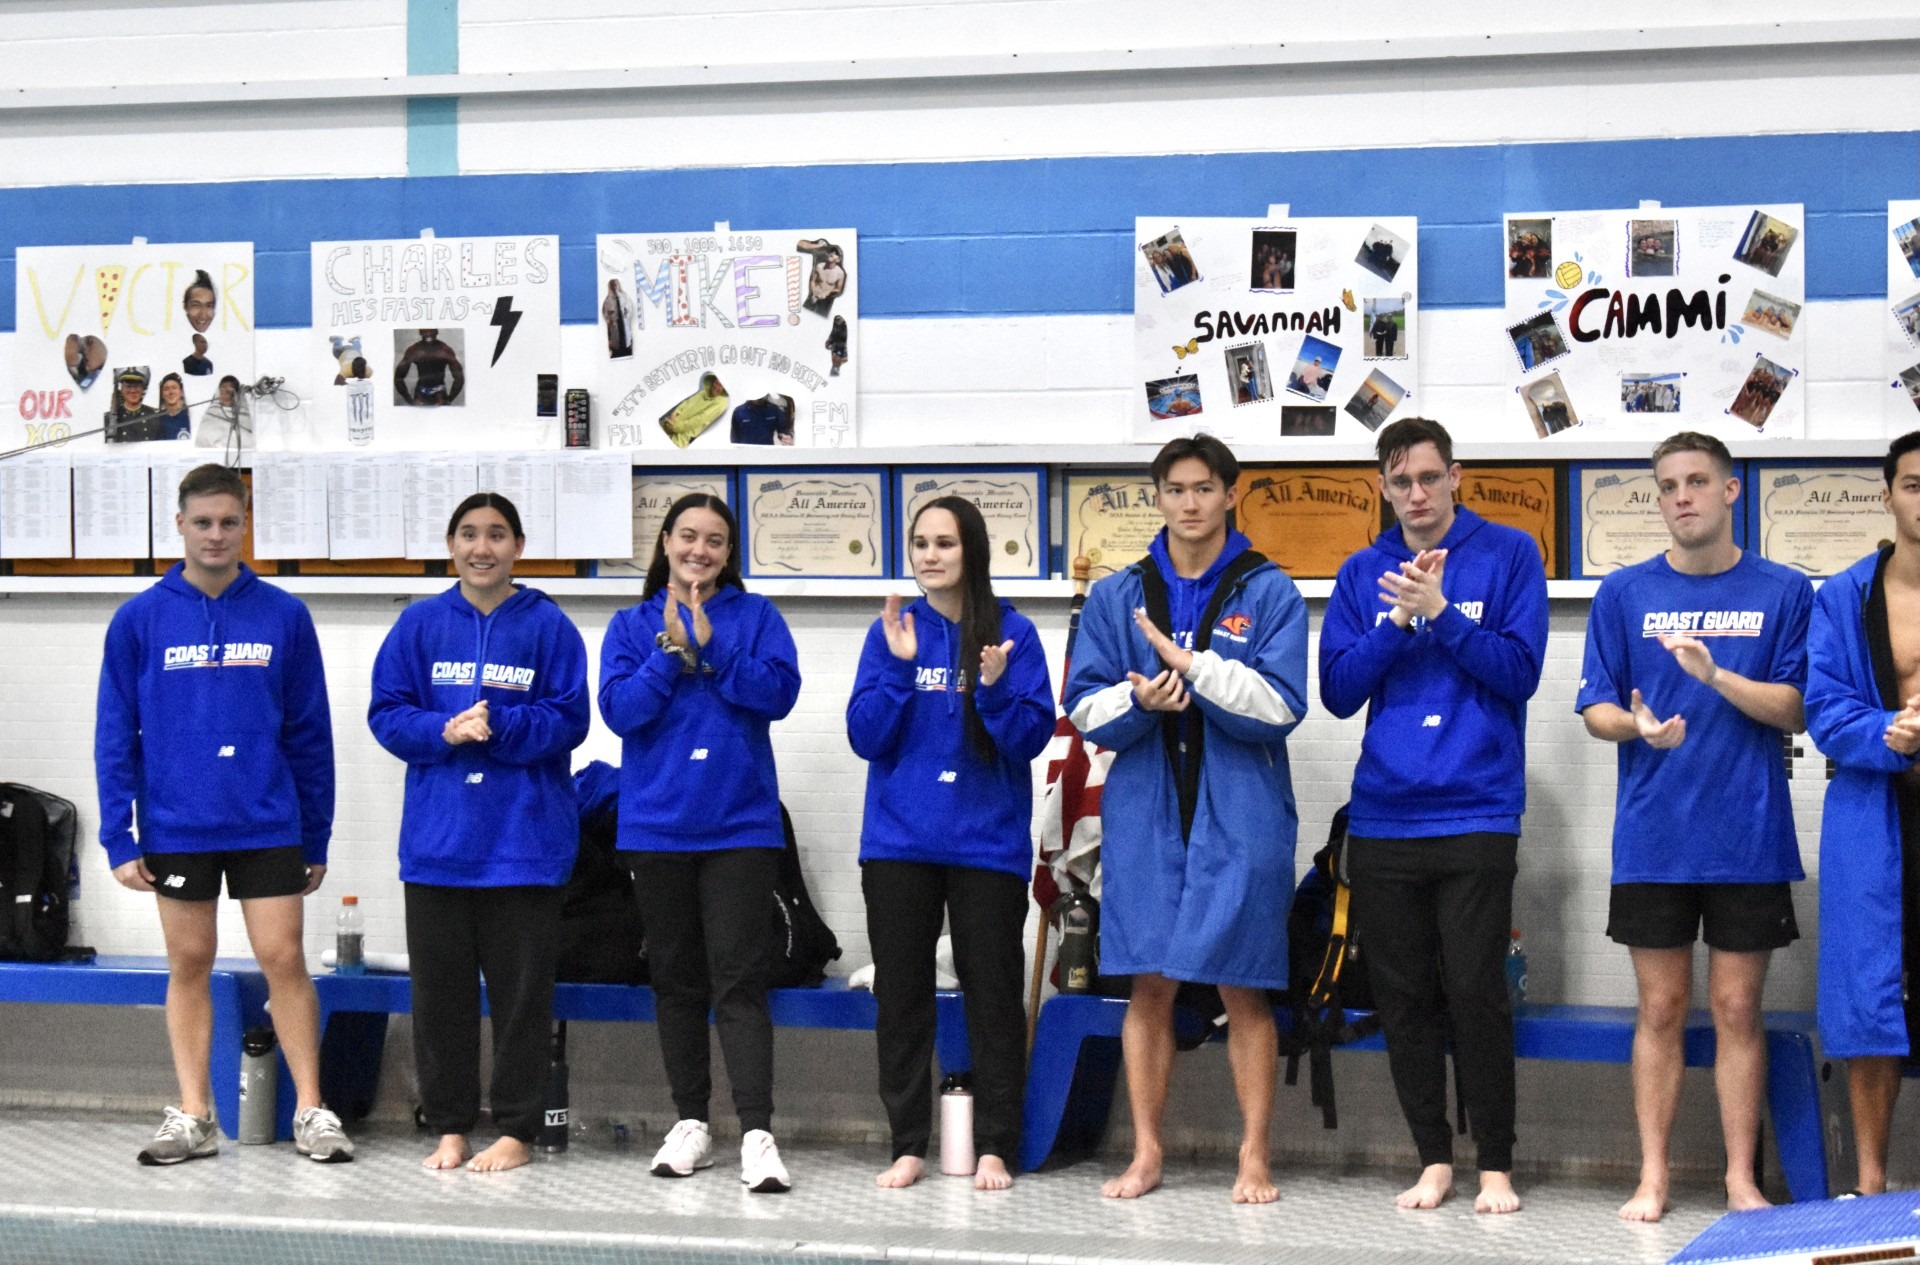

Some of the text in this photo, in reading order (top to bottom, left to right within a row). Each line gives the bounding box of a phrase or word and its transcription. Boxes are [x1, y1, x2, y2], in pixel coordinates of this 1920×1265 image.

[728, 235, 763, 252] 1650
[326, 238, 550, 295] CHARLES
[633, 254, 802, 331] MIKE!
[331, 296, 470, 327] HE'S FAST AS
[643, 349, 700, 392] BETTER
[698, 345, 716, 368] TO
[719, 344, 738, 365] GO
[740, 345, 768, 367] OUT
[768, 351, 792, 375] AND
[19, 388, 74, 421] OUR
[25, 422, 72, 448] XO
[635, 496, 658, 513] All
[787, 497, 867, 513] All America
[972, 497, 1024, 510] America
[1099, 490, 1130, 514] All
[1260, 481, 1370, 512] All America
[1468, 481, 1543, 512] America
[1624, 491, 1651, 508] All
[1804, 489, 1883, 507] All Ameri
[1642, 610, 1765, 631] COAST GUARD
[164, 642, 273, 665] COAST GUARD
[431, 661, 536, 686] COAST GUARD
